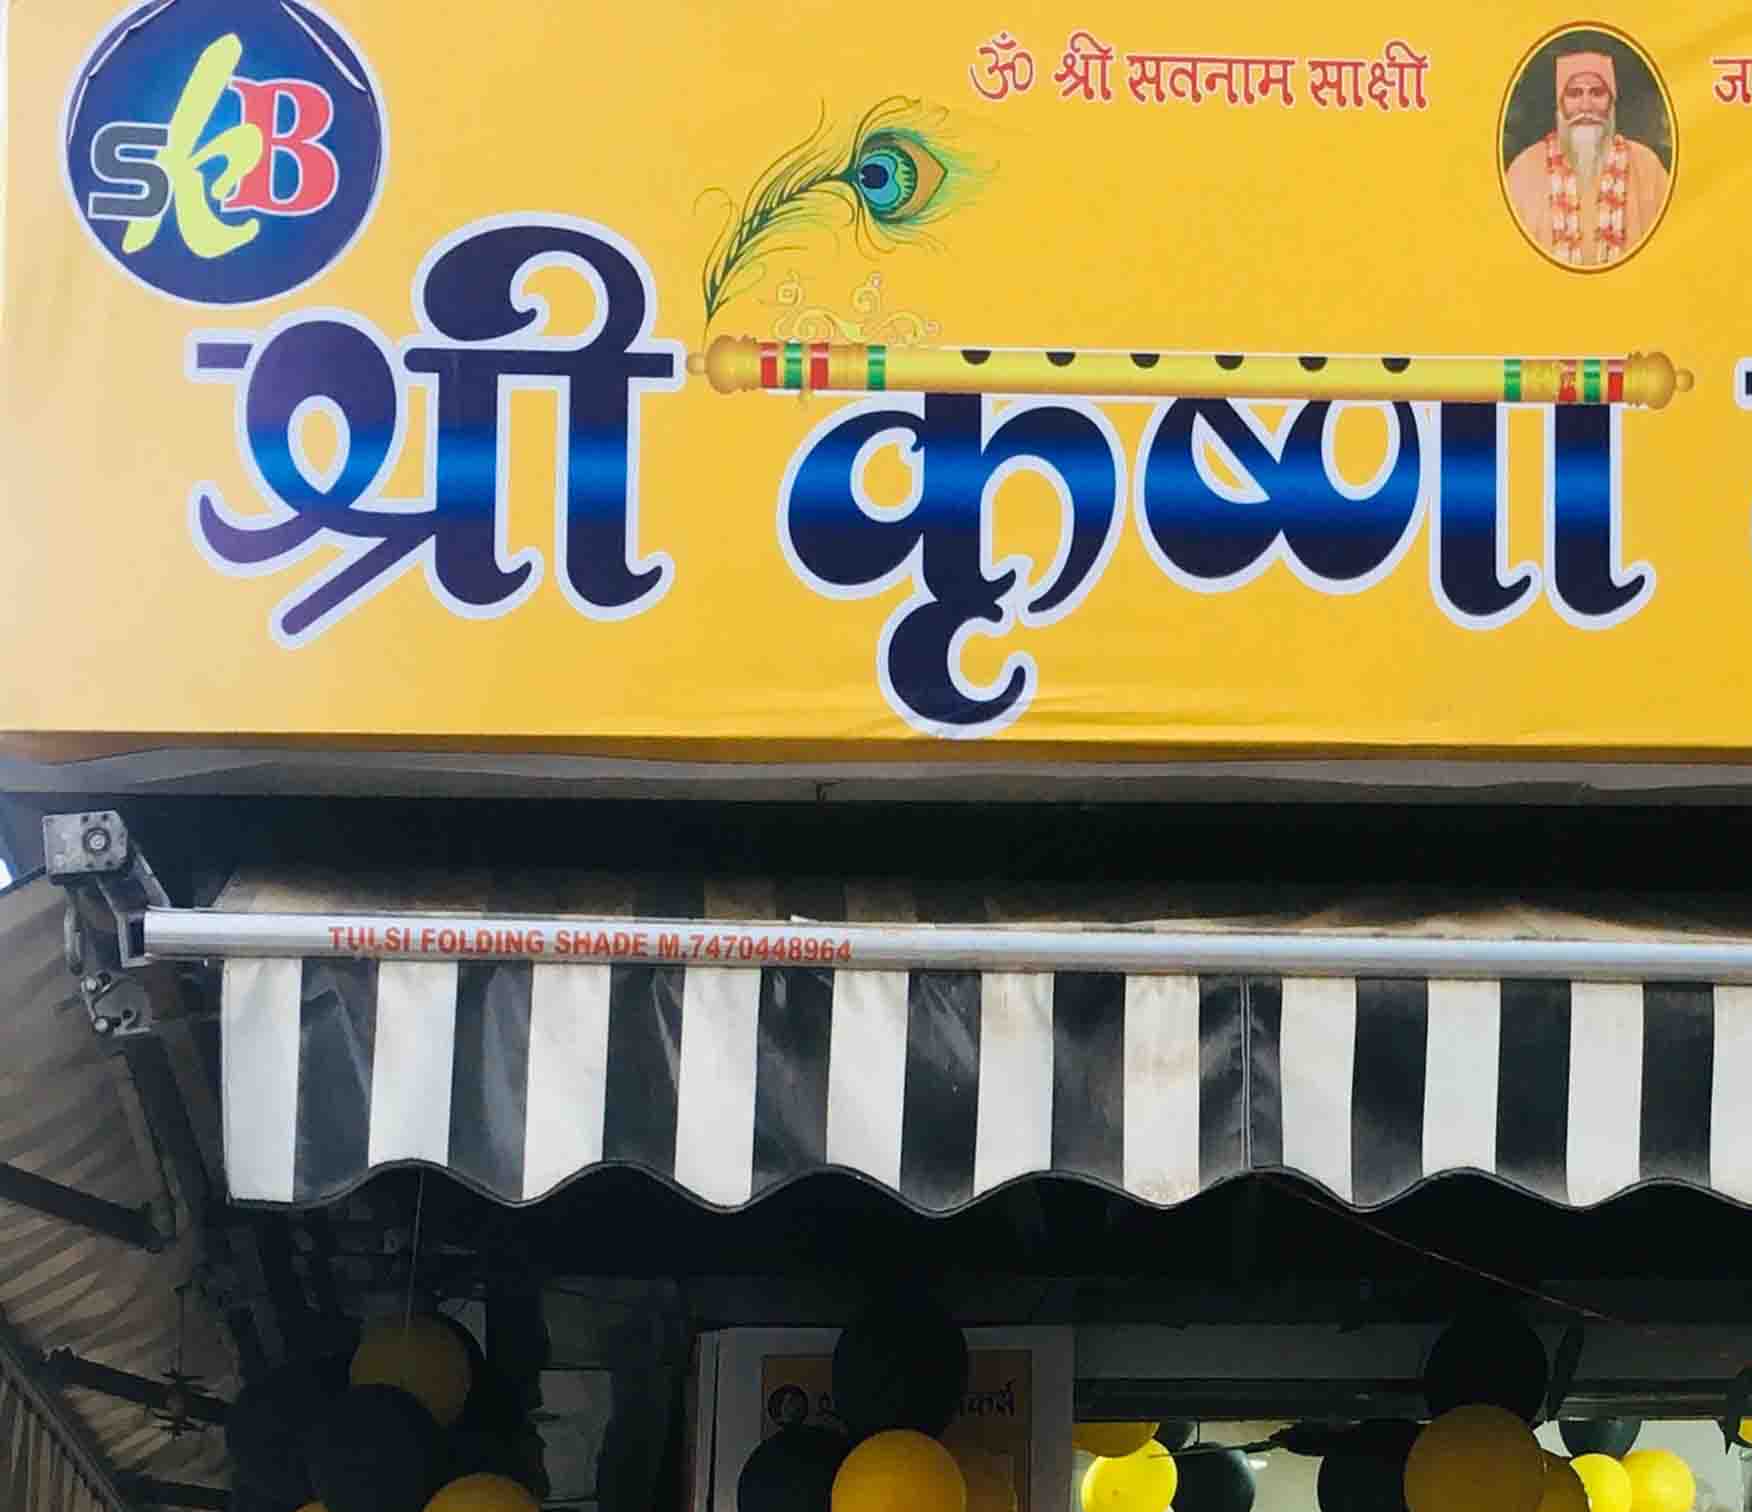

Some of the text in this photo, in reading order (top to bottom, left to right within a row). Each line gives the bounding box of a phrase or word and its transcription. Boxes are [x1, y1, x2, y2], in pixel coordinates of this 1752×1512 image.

[969, 31, 1430, 110] ॐ श्री सतनाम साक्षी
[192, 218, 680, 641] श्री
[782, 385, 1652, 732] कृष्णा
[328, 924, 852, 963] TULSI FOLDING SHADE M.7470448964
